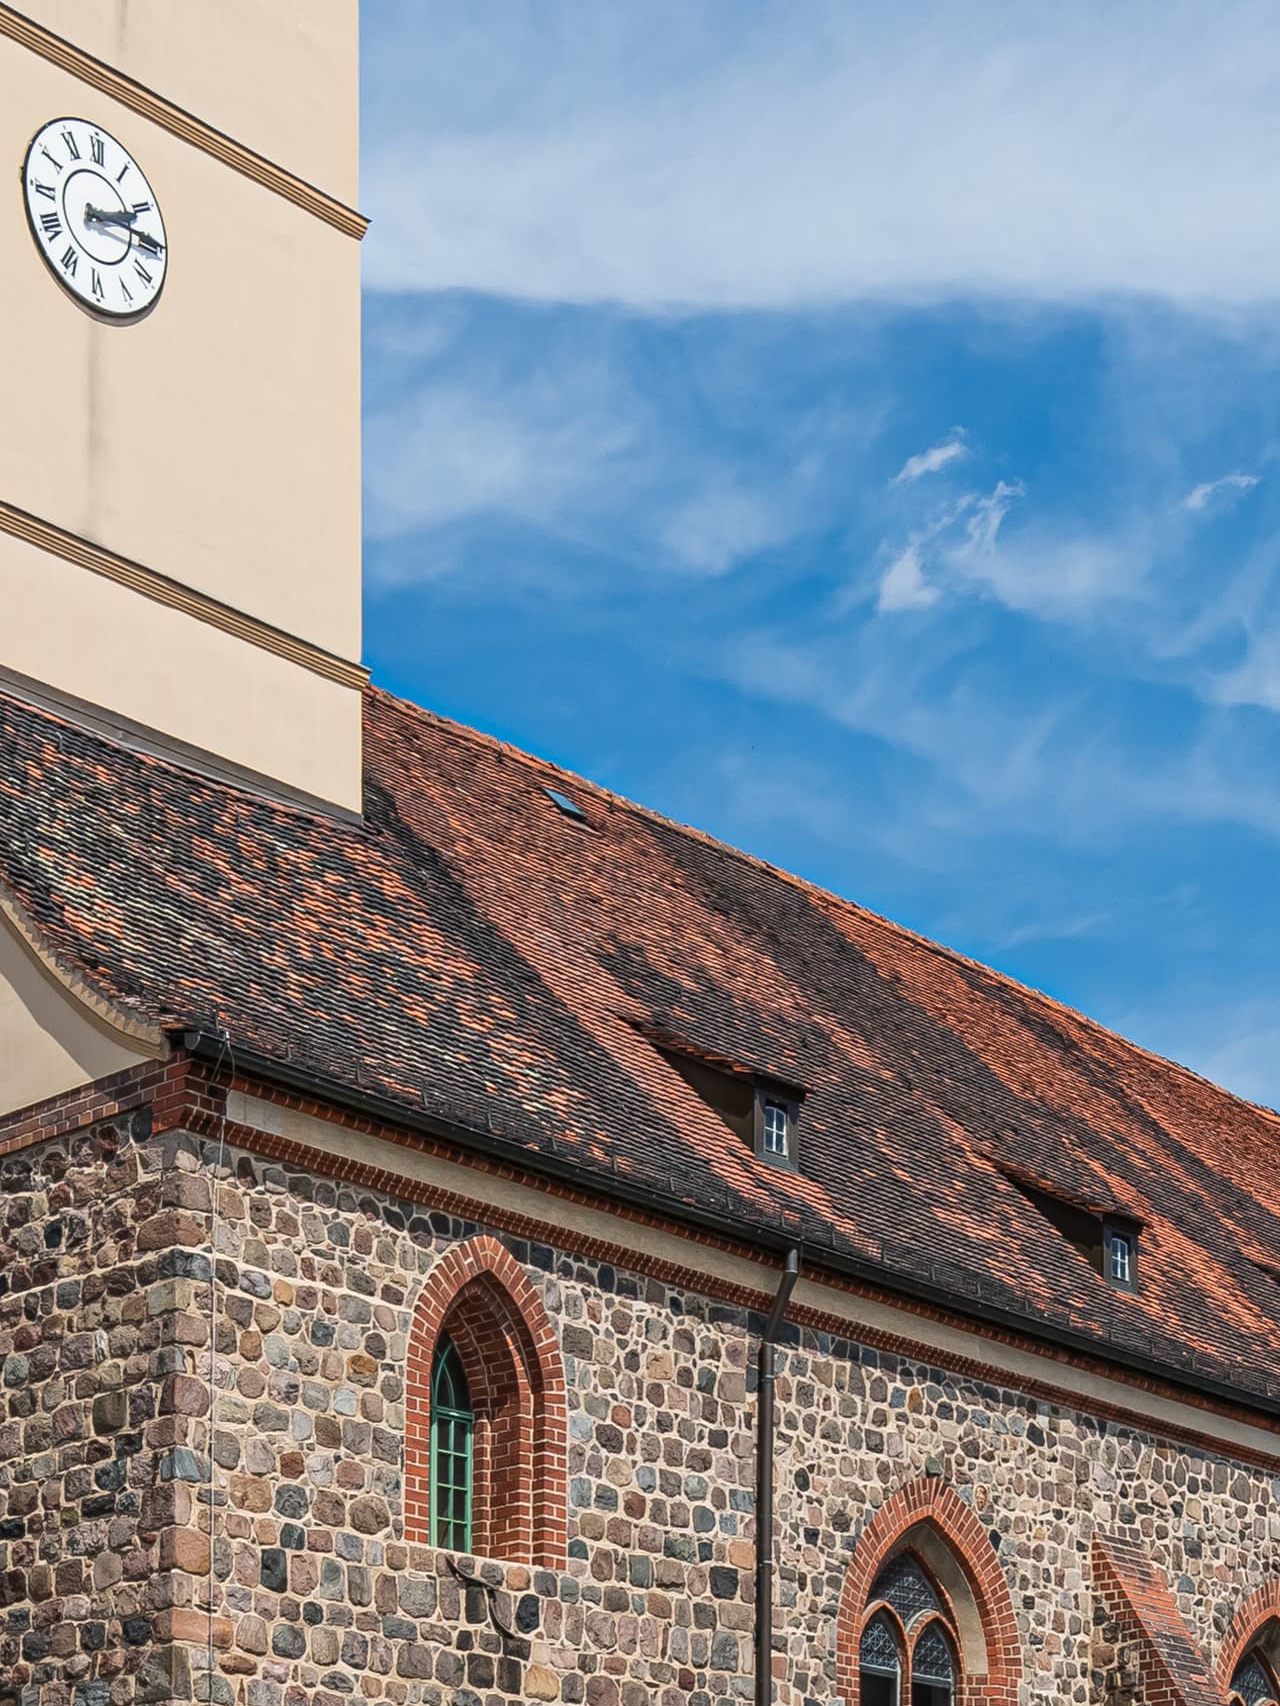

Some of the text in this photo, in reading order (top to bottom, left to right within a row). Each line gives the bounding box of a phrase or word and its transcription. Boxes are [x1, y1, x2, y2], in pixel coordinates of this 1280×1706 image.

[41, 146, 63, 174] X
[89, 134, 105, 168] XII
[117, 164, 130, 182] I
[35, 178, 56, 201] IX
[132, 201, 152, 214] II
[40, 212, 63, 243] VIII
[60, 247, 78, 278] VII
[133, 259, 153, 289] IV
[91, 267, 105, 299] VI
[119, 276, 134, 302] V
